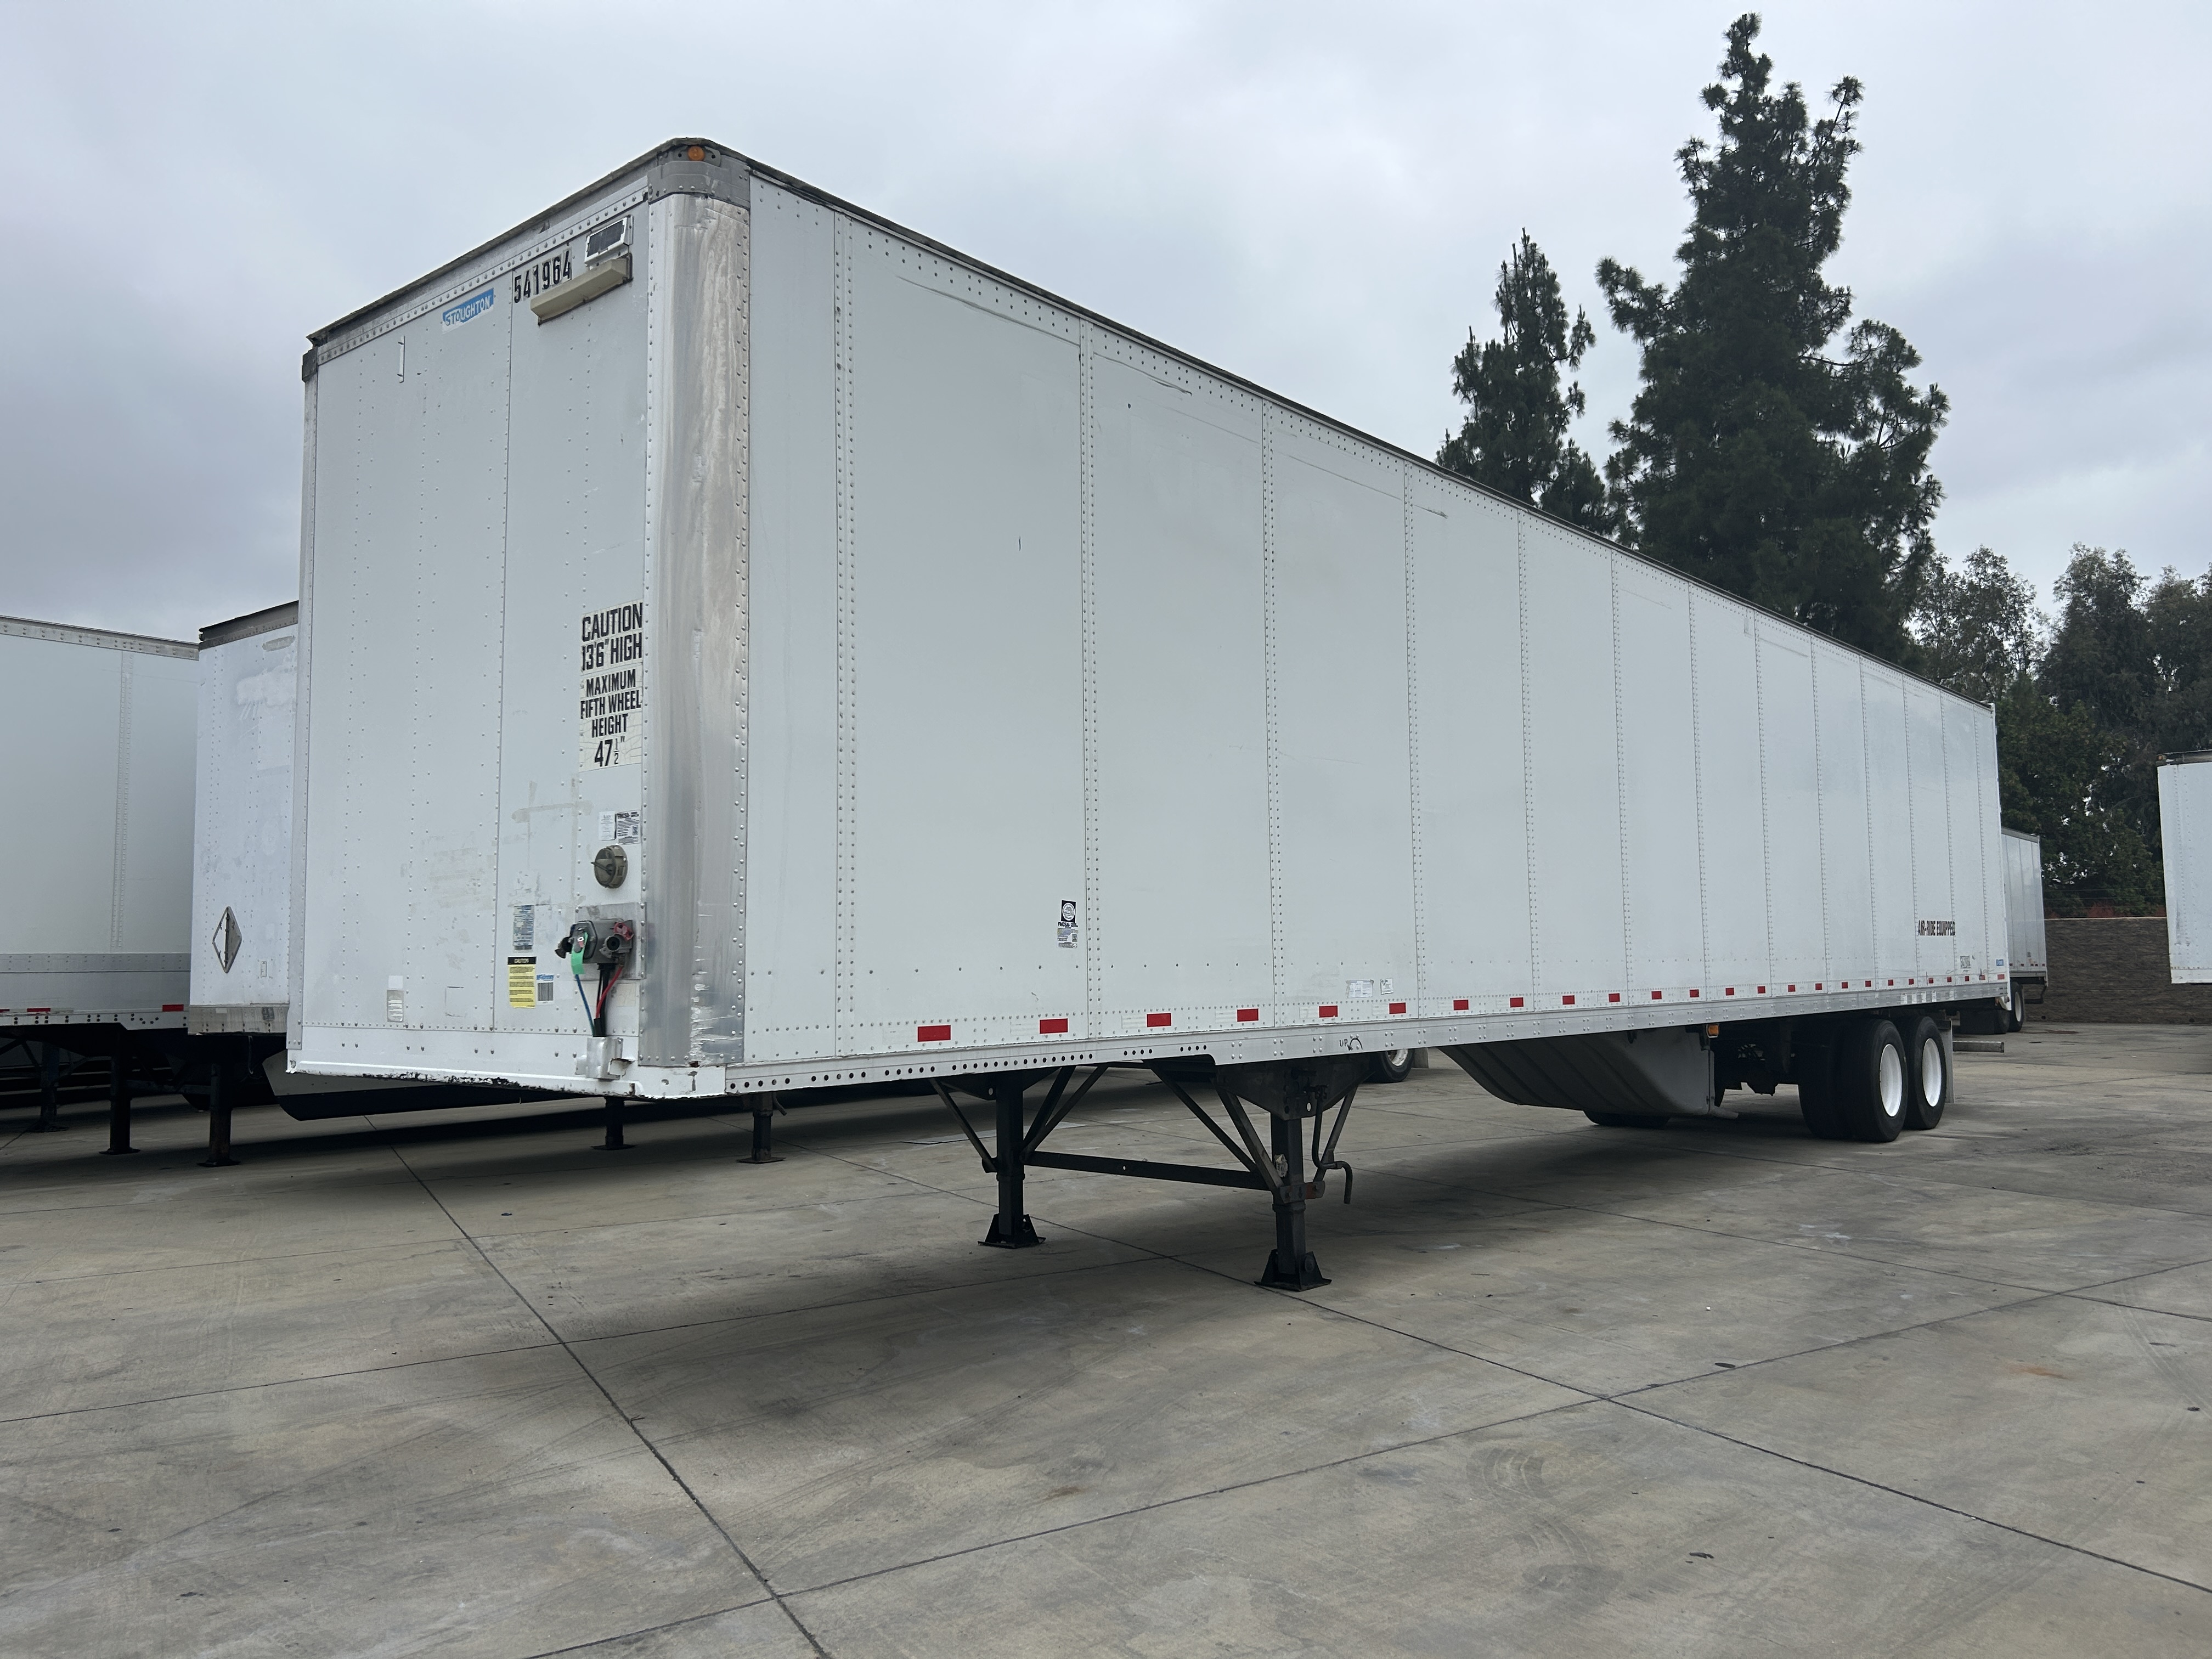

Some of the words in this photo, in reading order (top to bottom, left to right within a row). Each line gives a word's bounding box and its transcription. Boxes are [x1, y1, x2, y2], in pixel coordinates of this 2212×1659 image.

[514, 250, 571, 303] 541964
[445, 296, 492, 326] STOUGHTON
[582, 602, 643, 642] CAUTION
[611, 633, 642, 664] HIGH
[586, 669, 636, 697] MAXIMUM
[580, 697, 605, 719] FIFTH
[608, 690, 642, 713] WHEEL
[592, 714, 628, 738] HEIGHT
[1917, 920, 1936, 936] AIR-RIDE
[1937, 921, 1955, 936] EQUIPPED
[1339, 1039, 1348, 1047] UP
